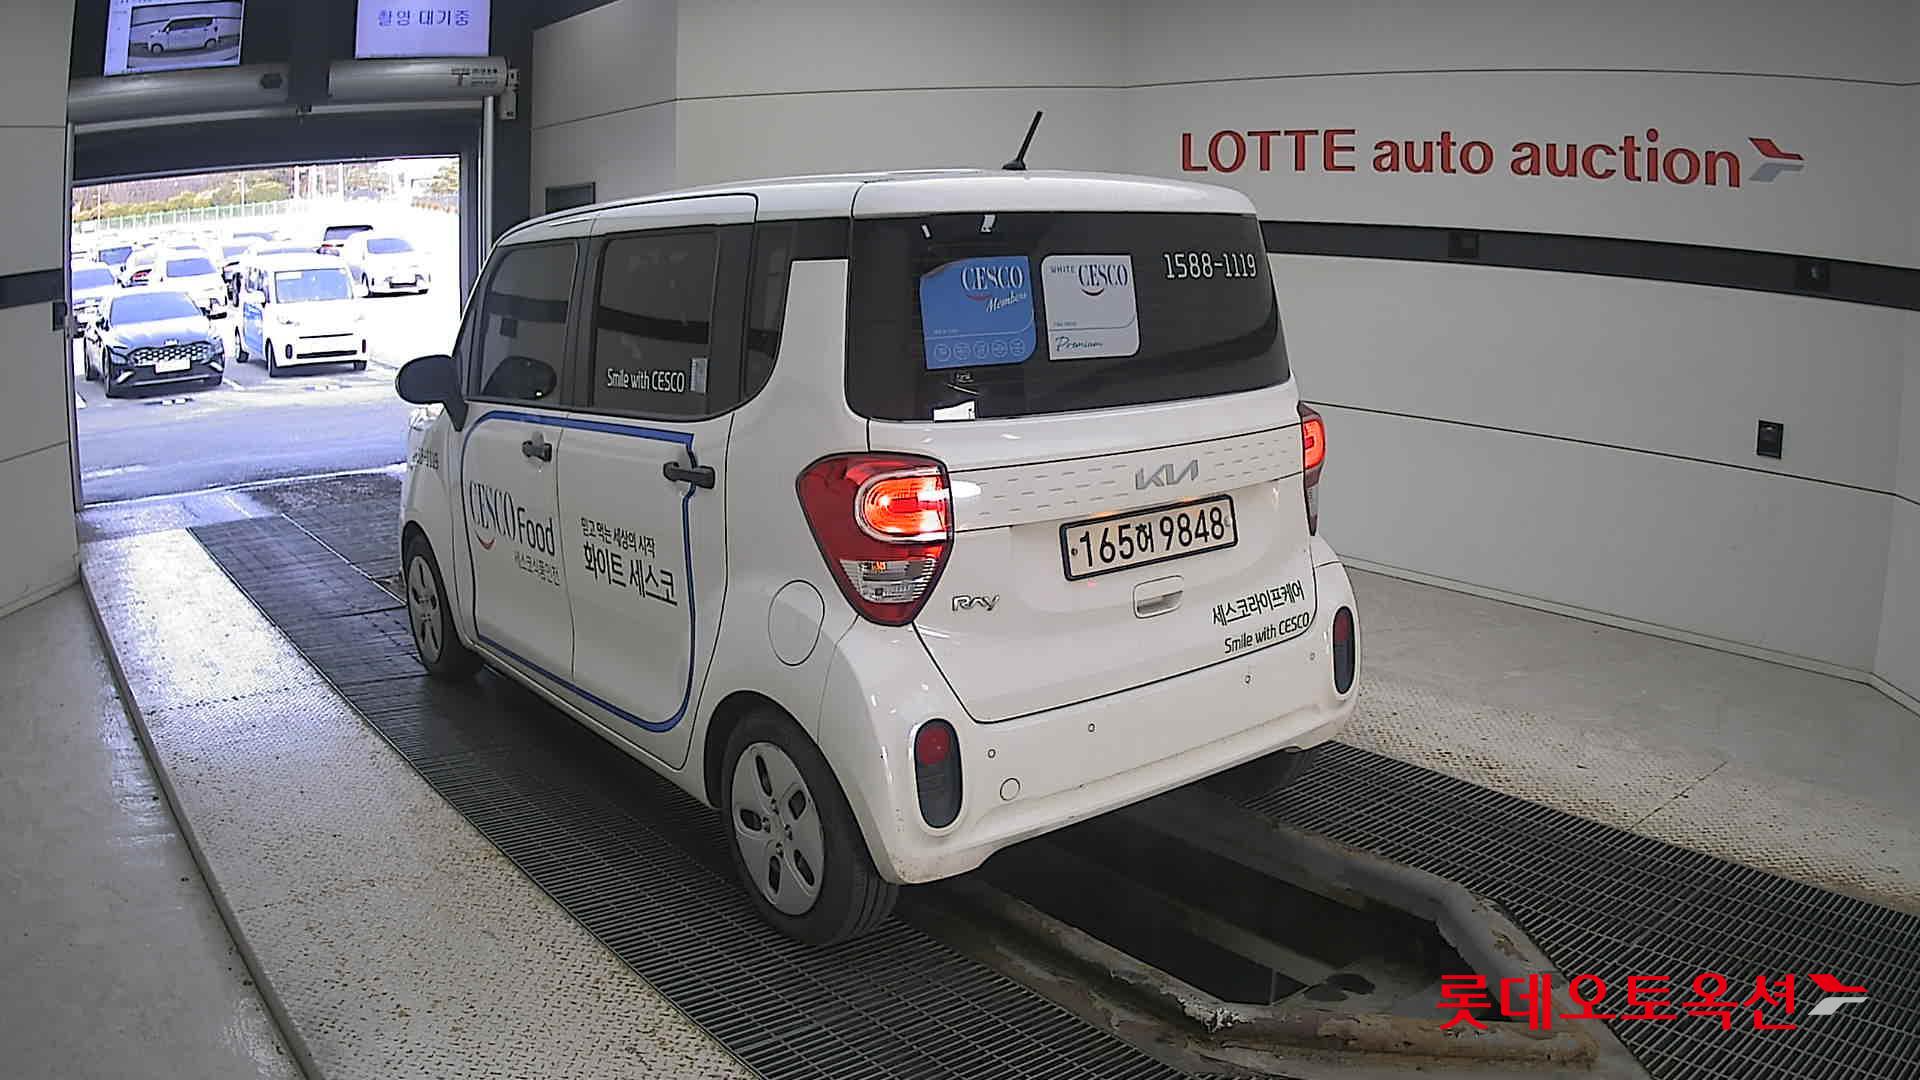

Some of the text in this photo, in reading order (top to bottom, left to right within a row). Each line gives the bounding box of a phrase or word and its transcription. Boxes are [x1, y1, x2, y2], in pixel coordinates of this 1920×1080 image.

[418, 9, 471, 27] 대기중
[1181, 127, 1741, 189] LOTTE auto auction
[960, 264, 1024, 292] CESCO
[1078, 263, 1129, 288] CESCO
[1163, 252, 1257, 279] 1588-1119
[607, 367, 685, 393] Smile with CESCO
[469, 479, 556, 557] CESCO Food
[1158, 506, 1225, 551] 9848
[583, 540, 679, 607] 화이트 세스코
[1211, 579, 1306, 627] 세스코라이프케어
[1224, 611, 1311, 655] Smile with CESCO
